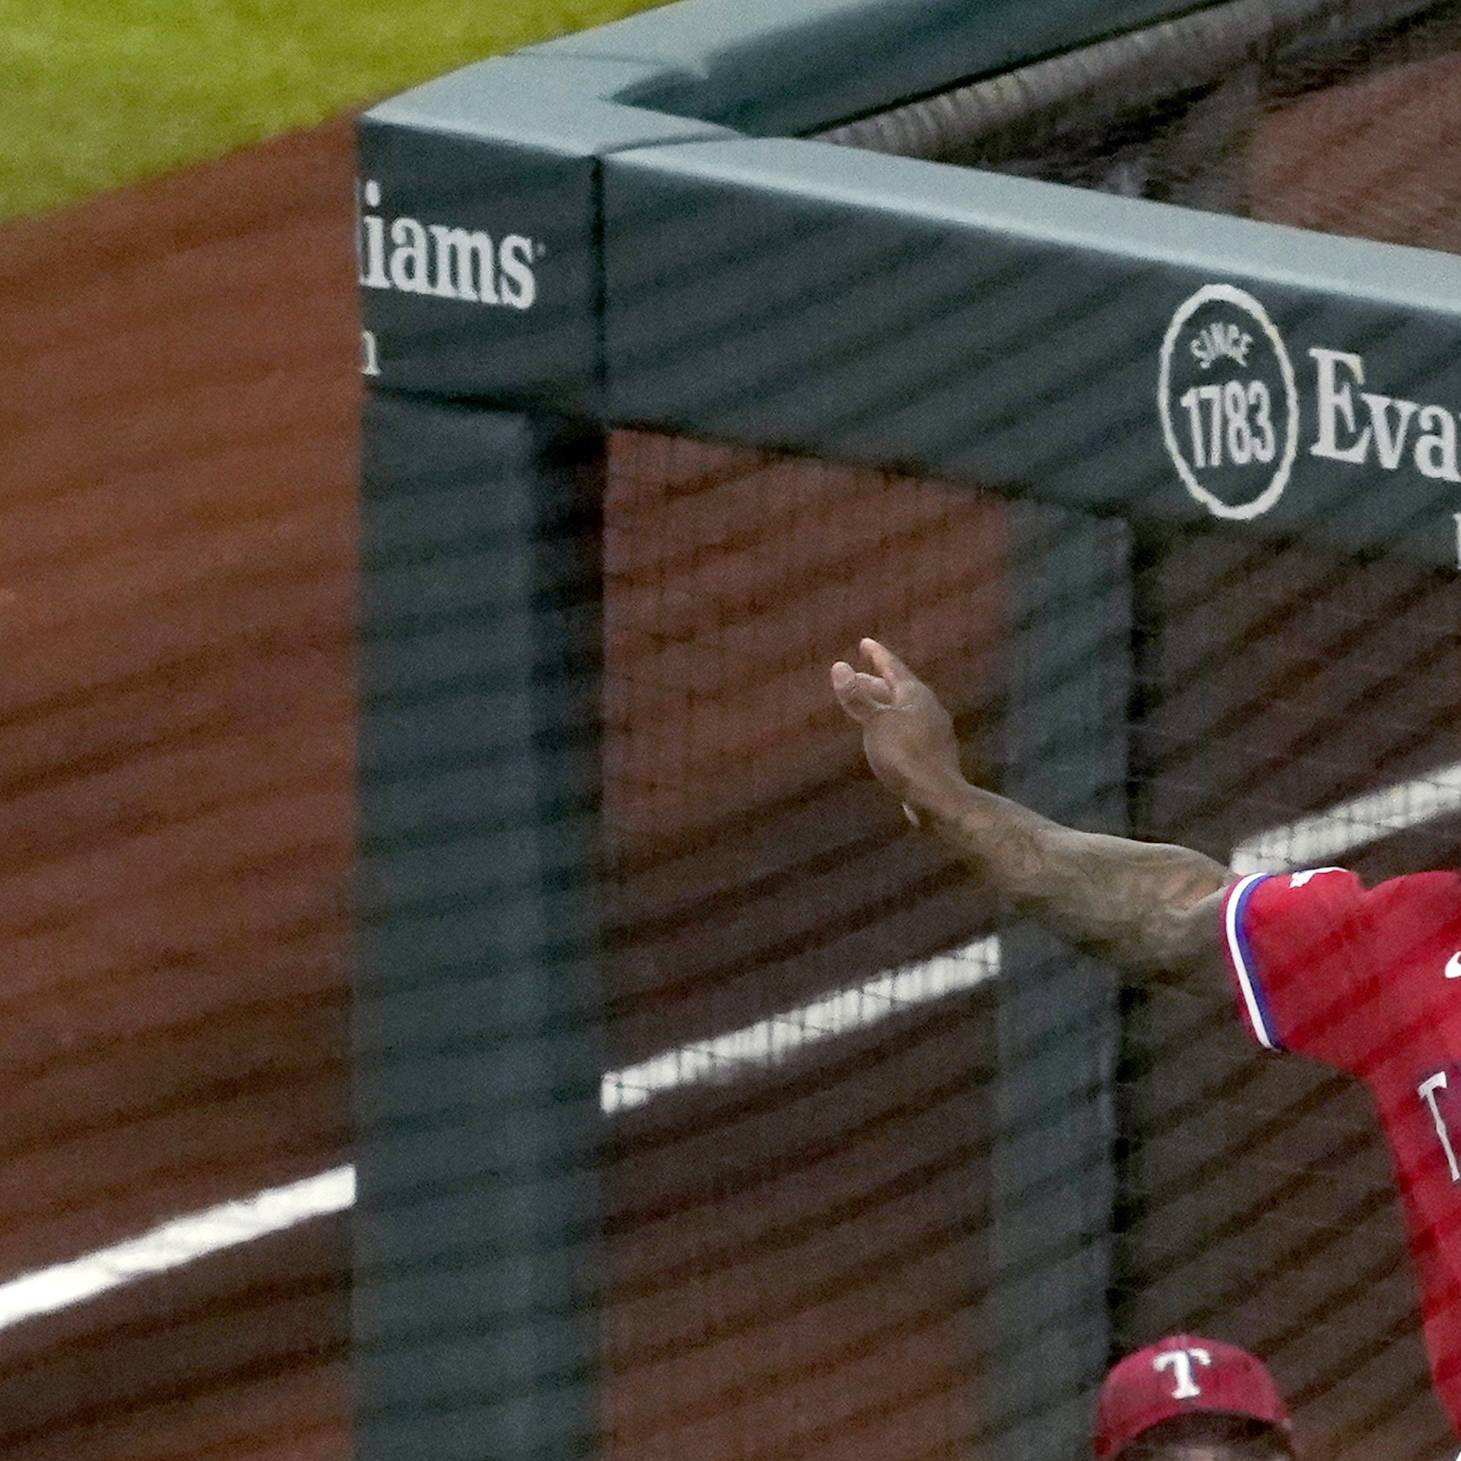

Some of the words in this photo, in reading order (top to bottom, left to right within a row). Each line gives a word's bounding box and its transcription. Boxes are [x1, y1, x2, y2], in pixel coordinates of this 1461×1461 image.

[356, 178, 536, 310] iams
[1179, 379, 1276, 468] 1783
[1152, 1347, 1211, 1399] T
